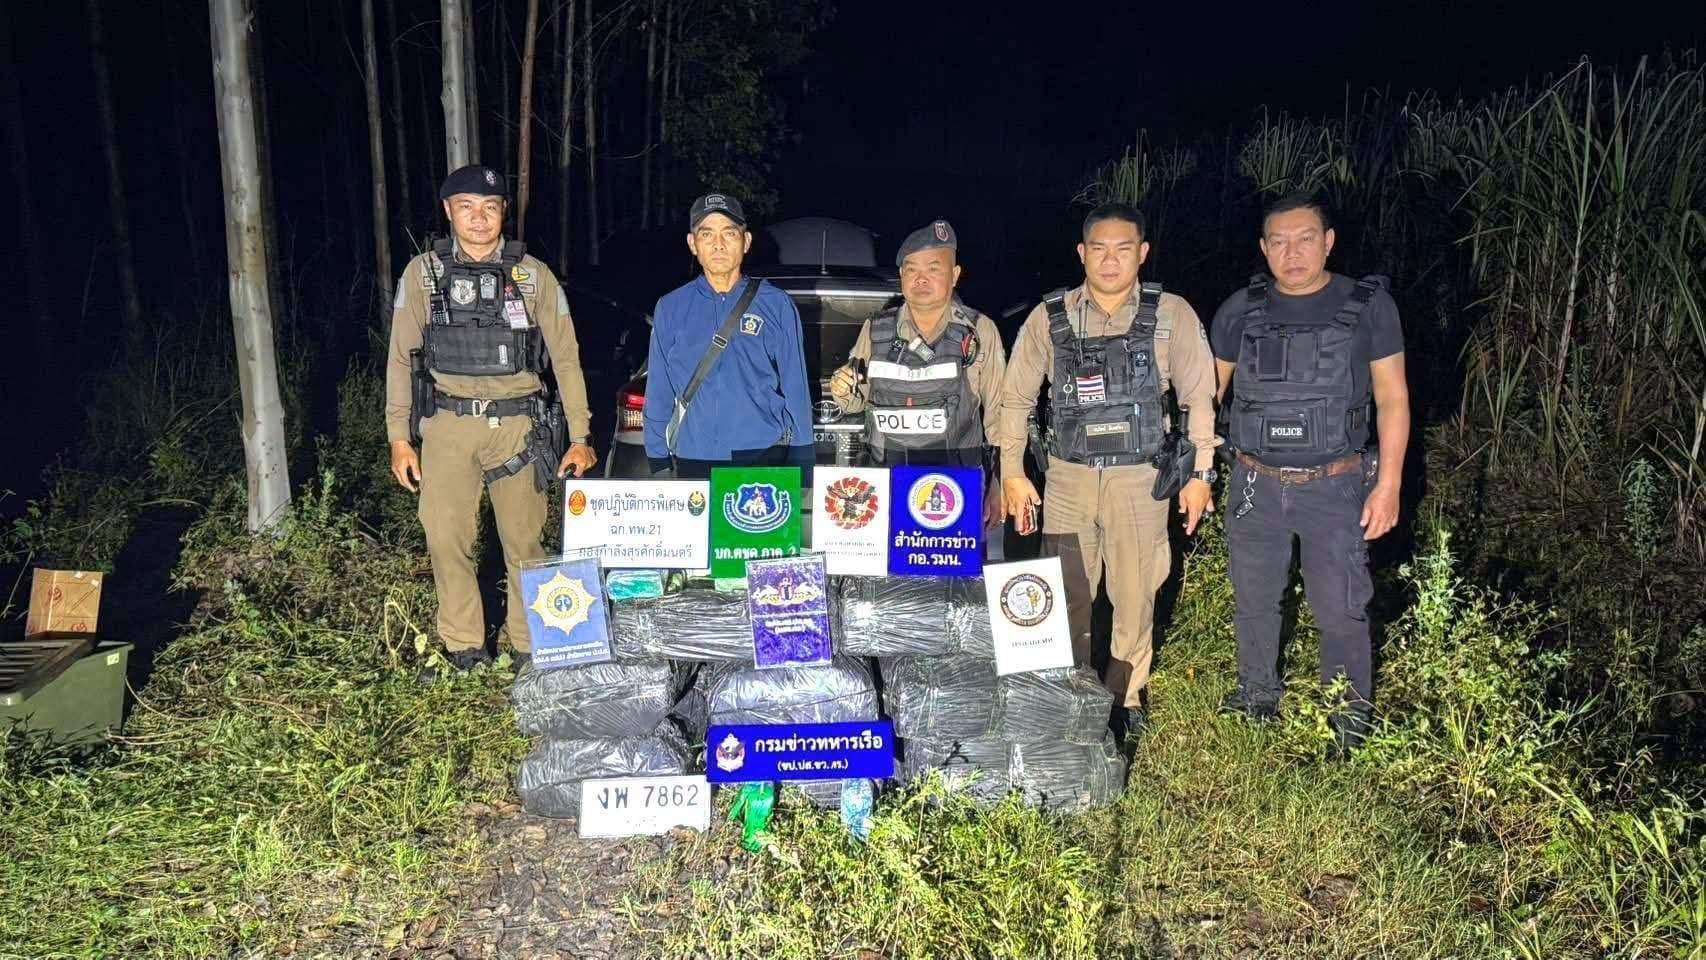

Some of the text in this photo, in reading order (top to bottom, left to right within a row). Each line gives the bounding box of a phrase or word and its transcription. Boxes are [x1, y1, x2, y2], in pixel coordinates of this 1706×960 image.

[876, 414, 943, 430] POLCE
[1271, 427, 1303, 436] POLICE
[590, 492, 685, 516] ชุดปฏิบัติการพิเศษ
[610, 524, 662, 536] ฉก.ทพ.21
[894, 530, 976, 549] สำนักการข่าว
[908, 552, 962, 566] กอ.รมน.
[755, 729, 883, 753] กรมข่าวทหารเรือ
[643, 784, 699, 808] 7862
